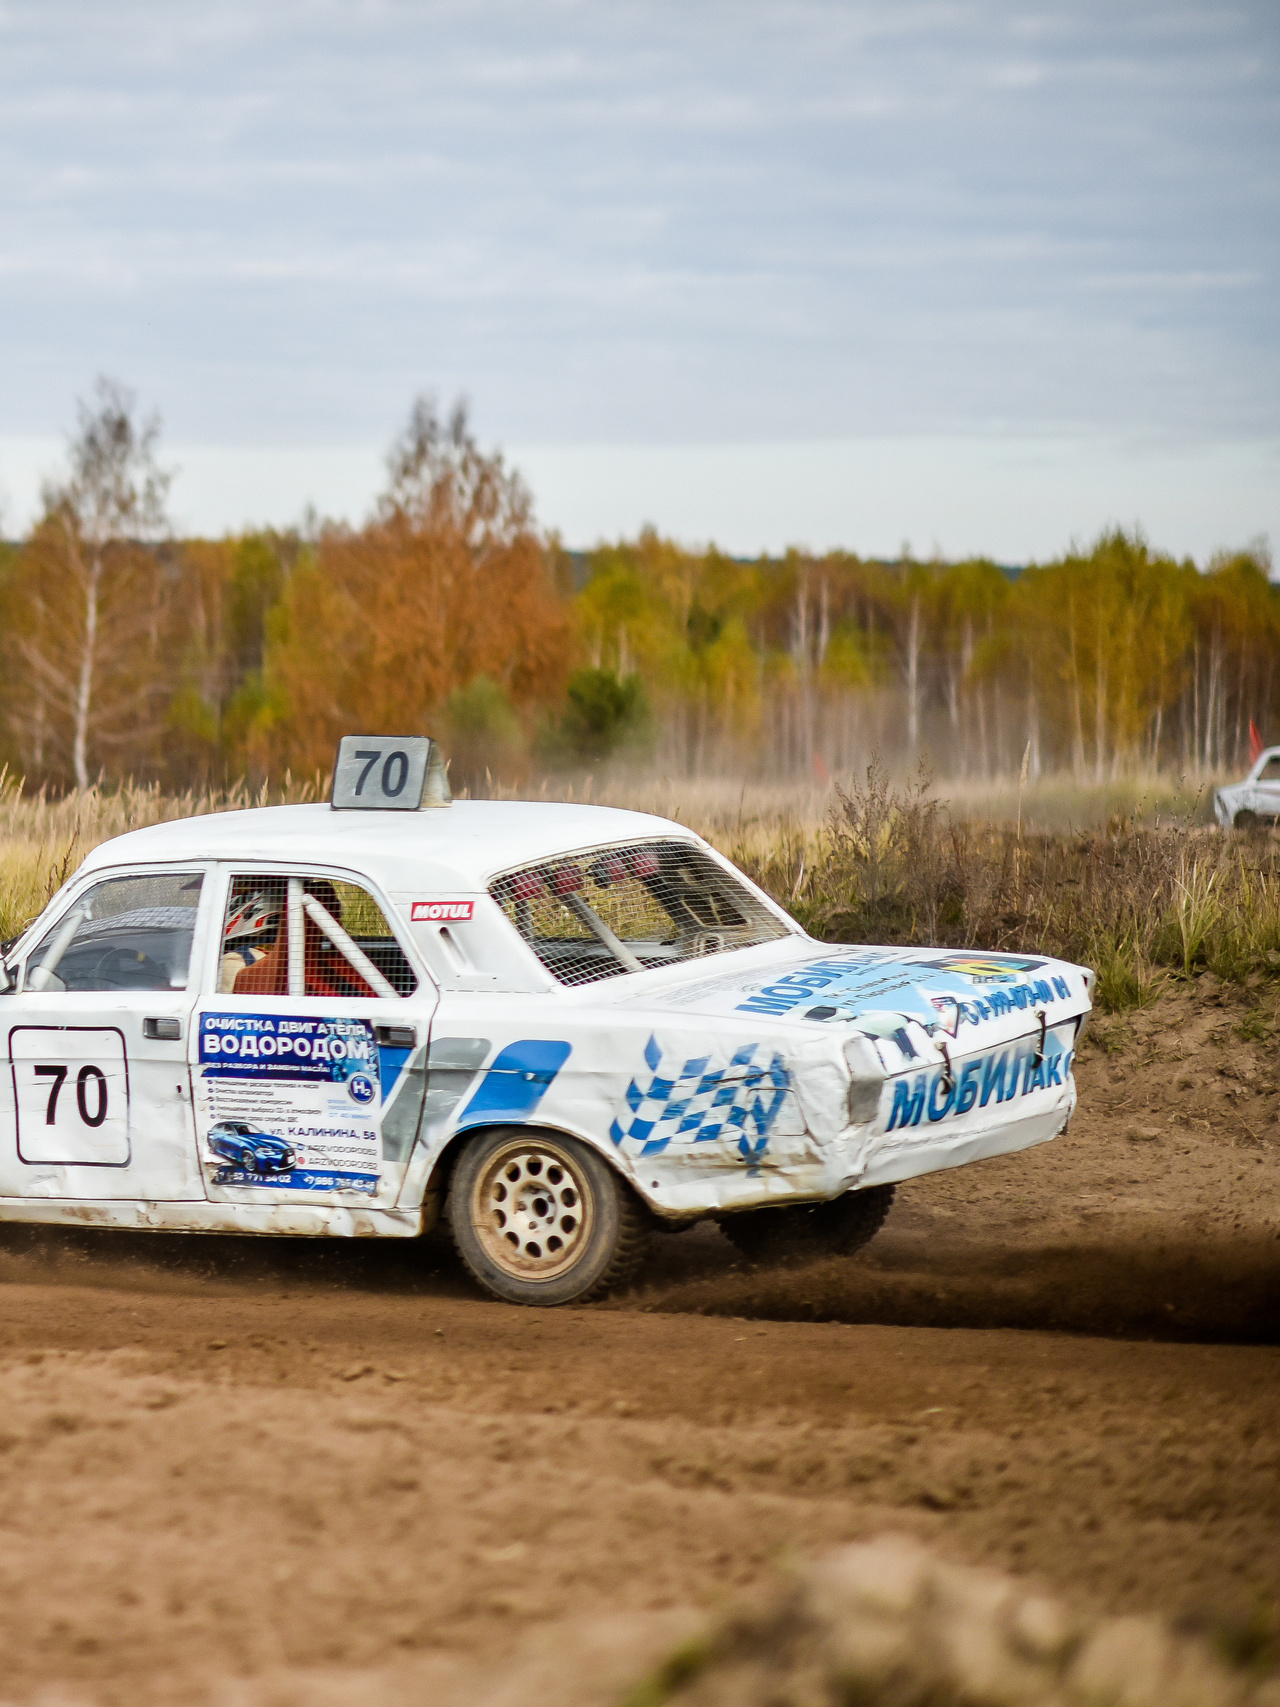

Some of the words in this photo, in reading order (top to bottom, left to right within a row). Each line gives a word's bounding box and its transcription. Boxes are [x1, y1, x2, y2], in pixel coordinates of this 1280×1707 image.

[354, 750, 410, 798] 70
[412, 903, 472, 919] MOTUL
[205, 1018, 274, 1032] ОЧИСТКА
[203, 1034, 369, 1060] ВОДОРОДОМ
[33, 1064, 108, 1128] 70
[288, 1127, 360, 1140] КАЛИНИНА,
[363, 1131, 376, 1140] 58
